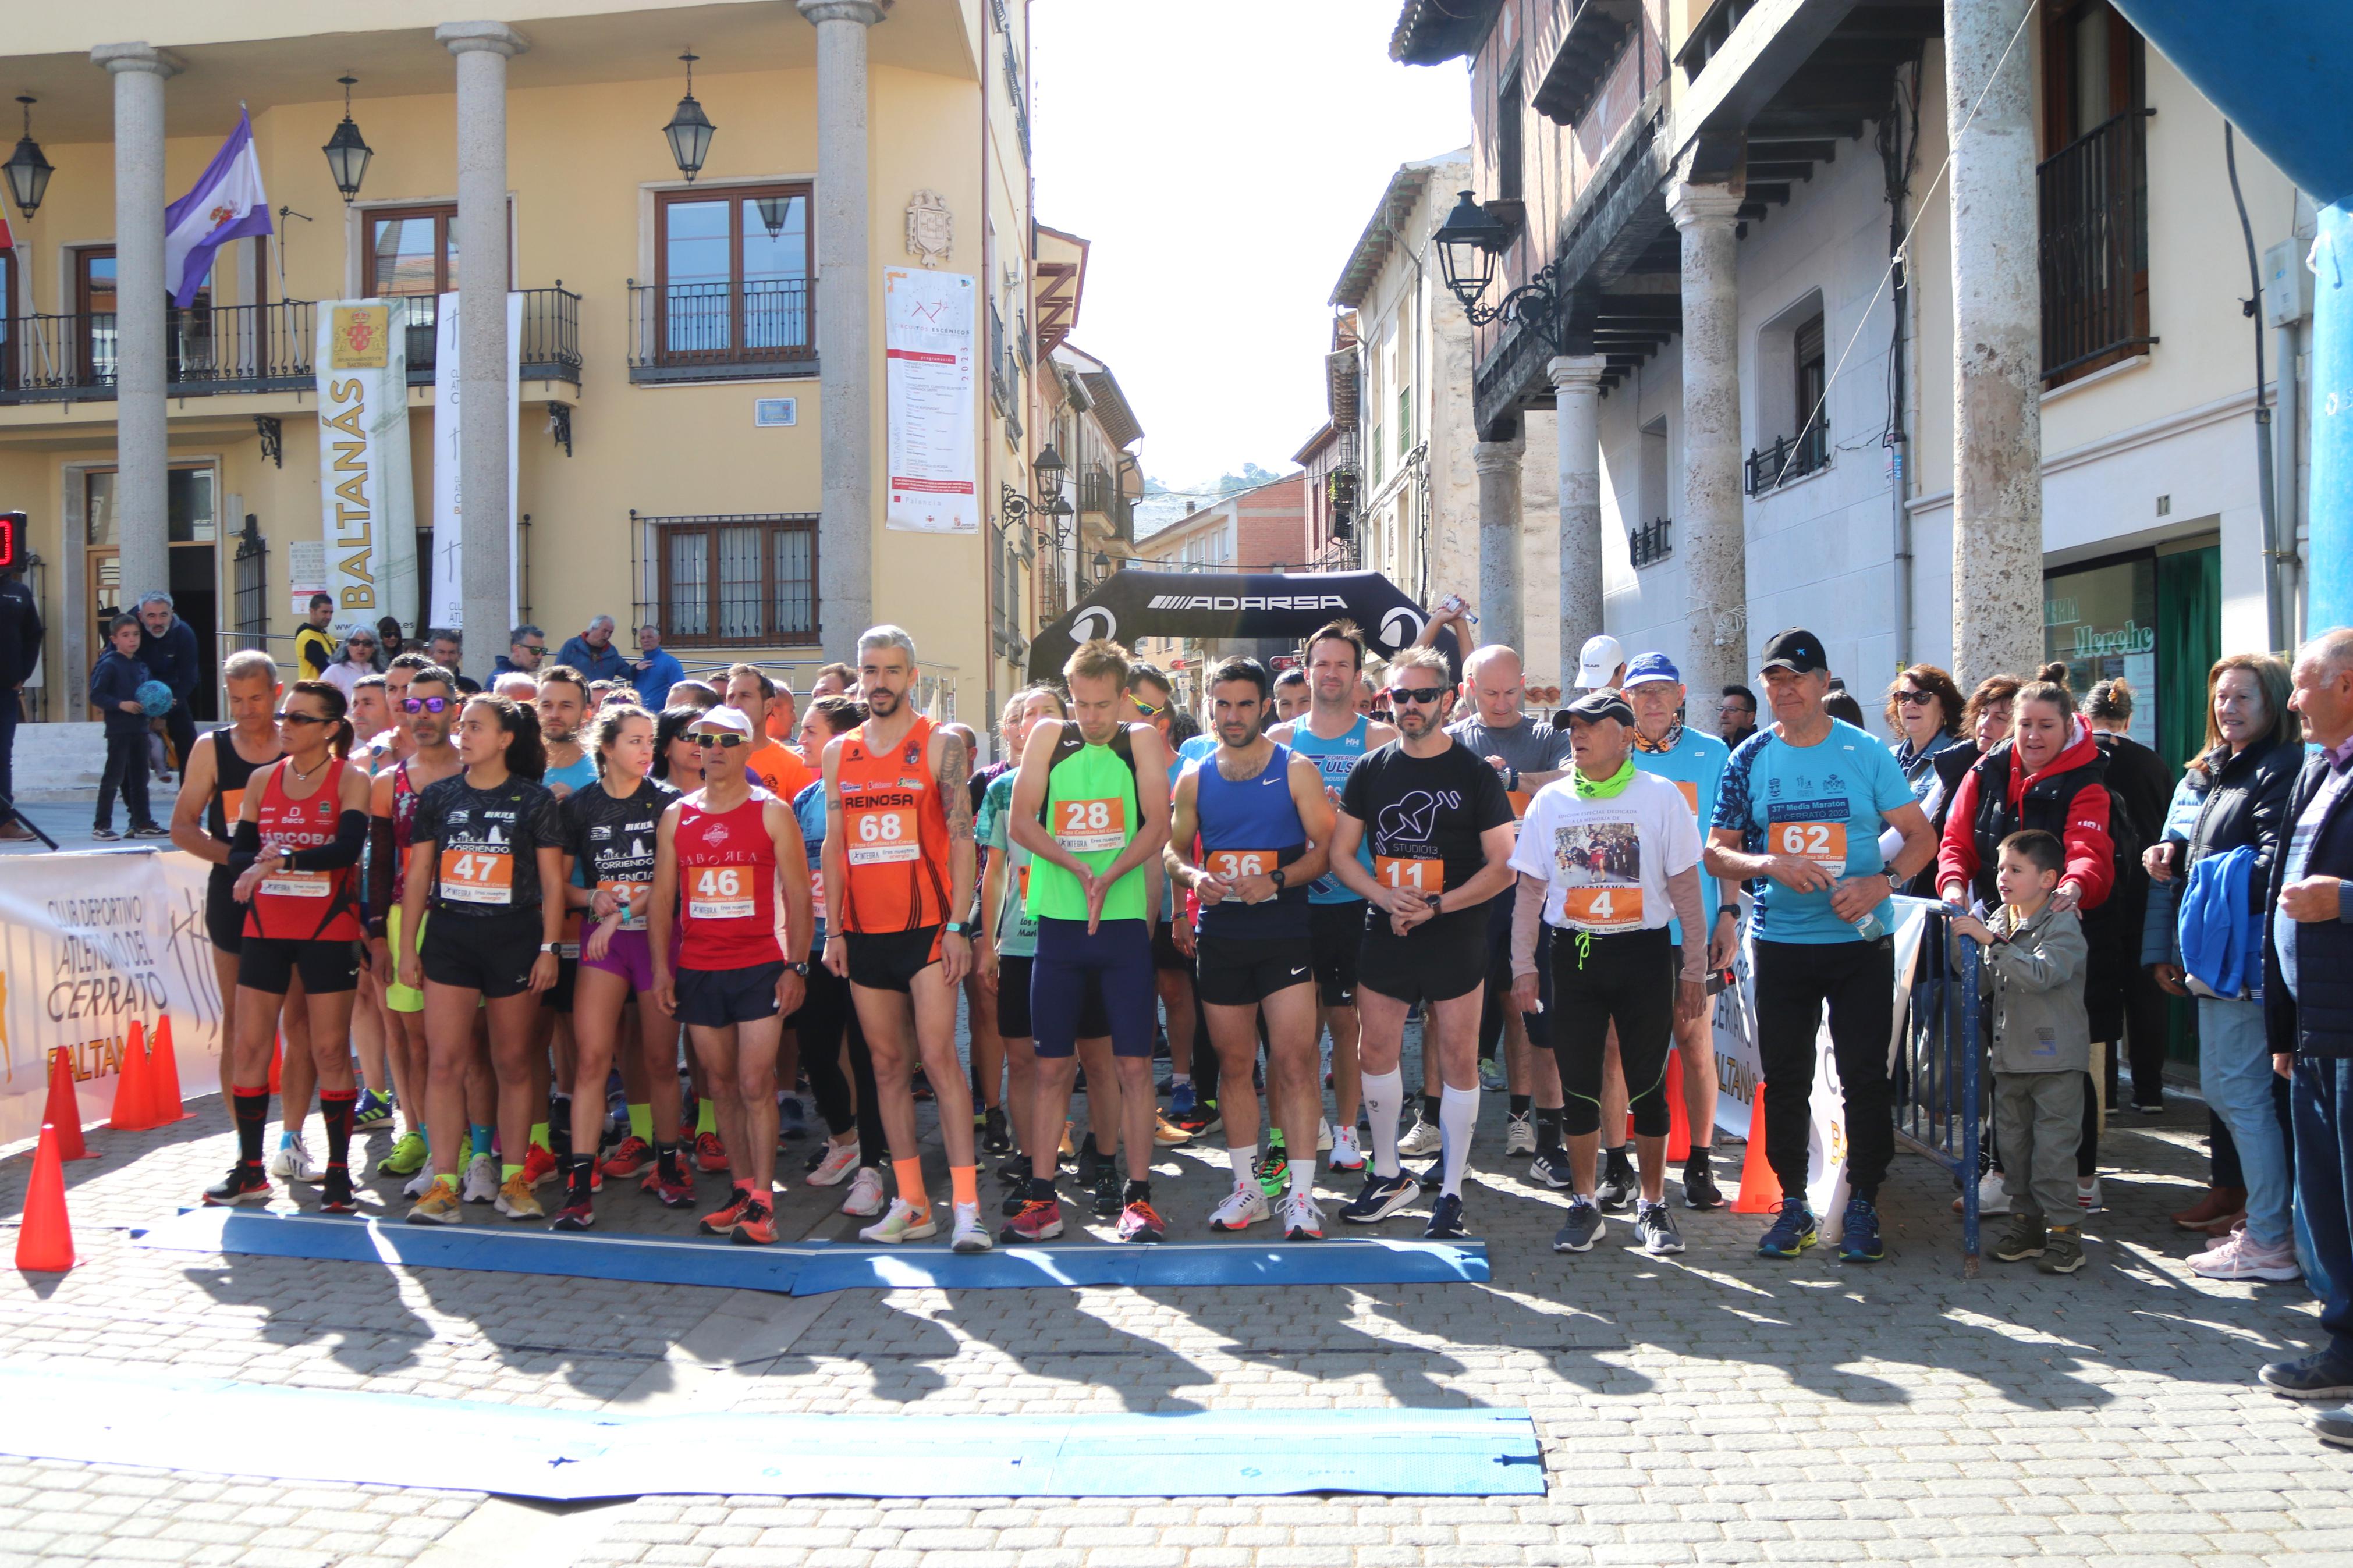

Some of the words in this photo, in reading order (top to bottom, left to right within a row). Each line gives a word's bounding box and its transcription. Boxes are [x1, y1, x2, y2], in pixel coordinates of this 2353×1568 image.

[321, 378, 375, 610] BALTANÁS
[1186, 595, 1348, 610] ADARSA
[2074, 620, 2153, 659] Merche
[845, 794, 913, 810] REINOSA
[1066, 802, 1109, 830] 28
[1783, 810, 1827, 821] CERRATO
[1828, 808, 1849, 817] 2023
[1786, 802, 1811, 812] Media
[1812, 800, 1846, 809] Maratón
[859, 813, 902, 842] 68
[1783, 825, 1830, 854] 62
[447, 844, 509, 854] CORRIENDO
[1393, 843, 1438, 855] STUDIO13
[453, 854, 498, 881] 47
[595, 858, 655, 869] CORRIENDO
[1219, 854, 1262, 880] 36
[1386, 861, 1422, 889] 11
[698, 869, 739, 897] 46
[80, 895, 142, 927] DEPORTIVO
[1589, 891, 1614, 919] 4
[47, 971, 168, 1023] CERRATO
